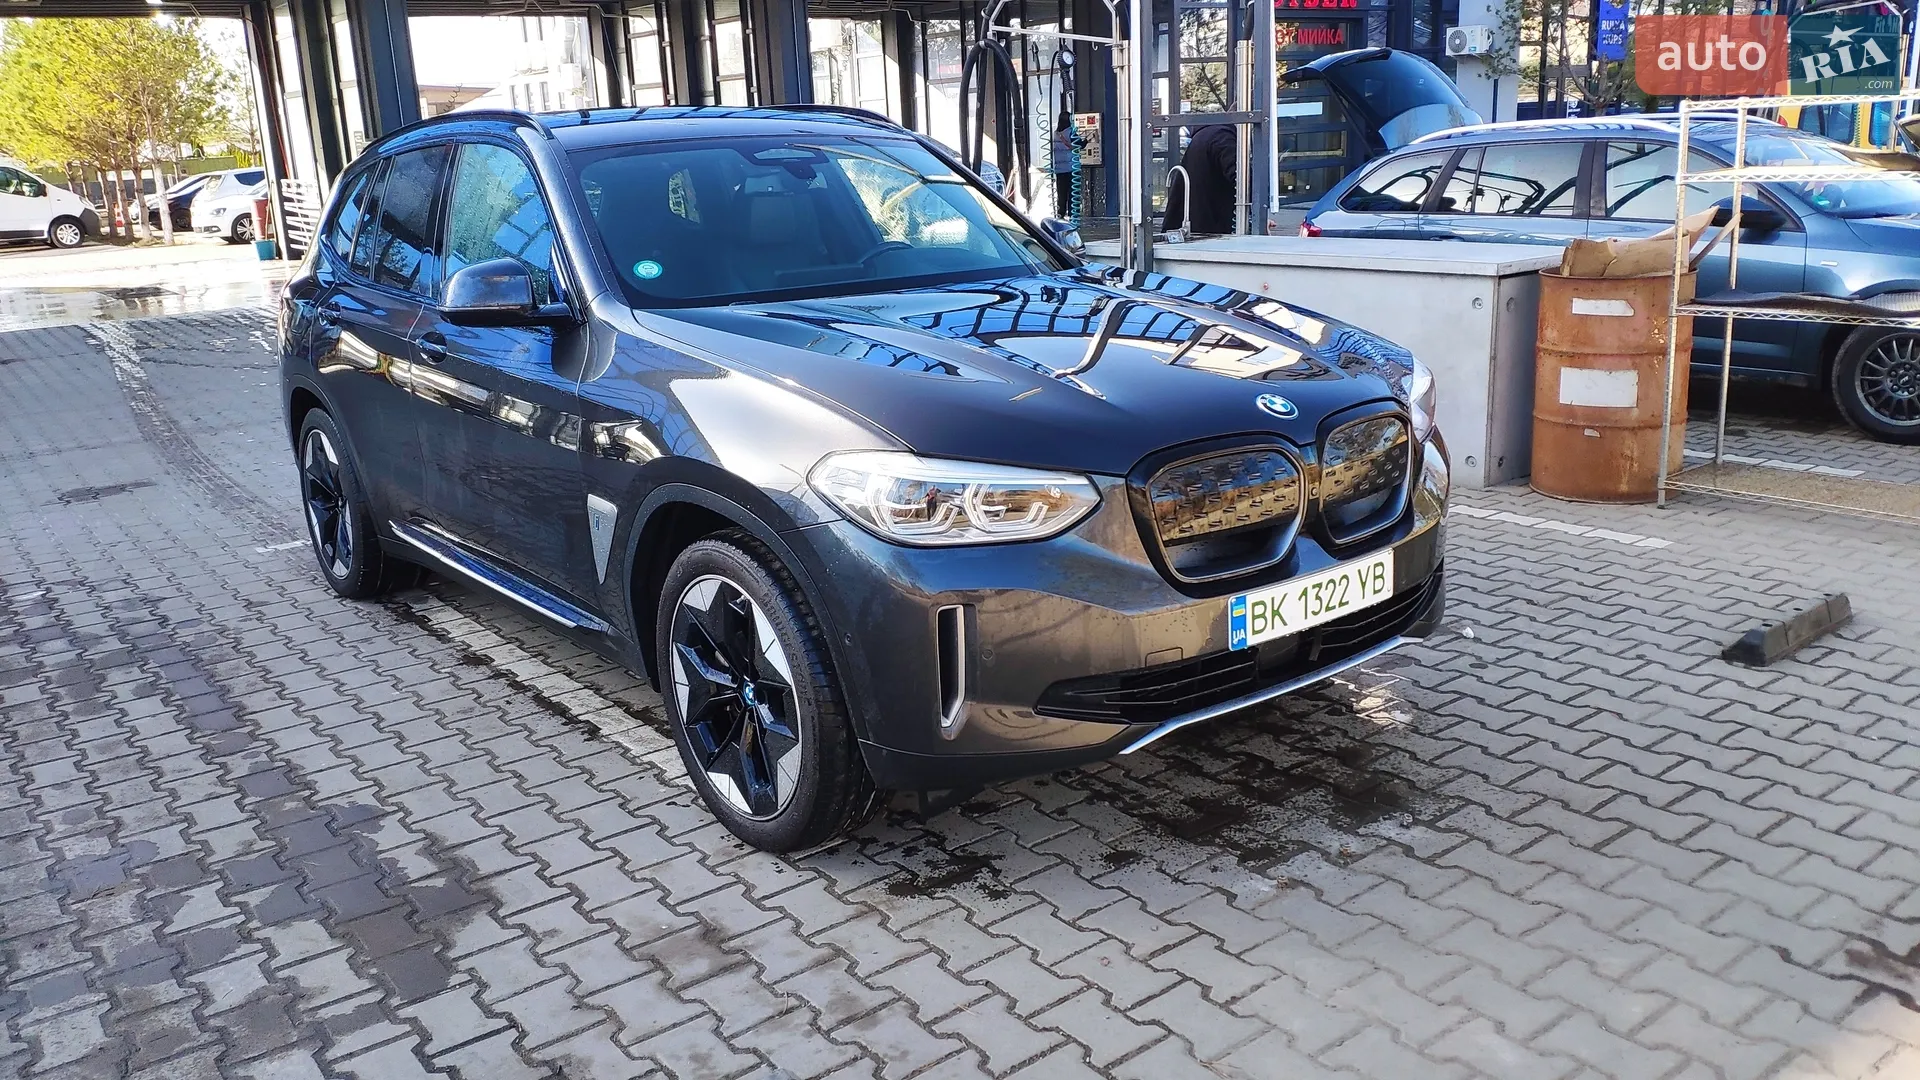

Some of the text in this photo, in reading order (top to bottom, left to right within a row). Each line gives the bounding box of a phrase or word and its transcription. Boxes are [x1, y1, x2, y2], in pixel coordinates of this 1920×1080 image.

[1297, 25, 1344, 45] МИЙКА
[1251, 561, 1386, 636] BK 1322 YB
[1232, 628, 1247, 642] UA
